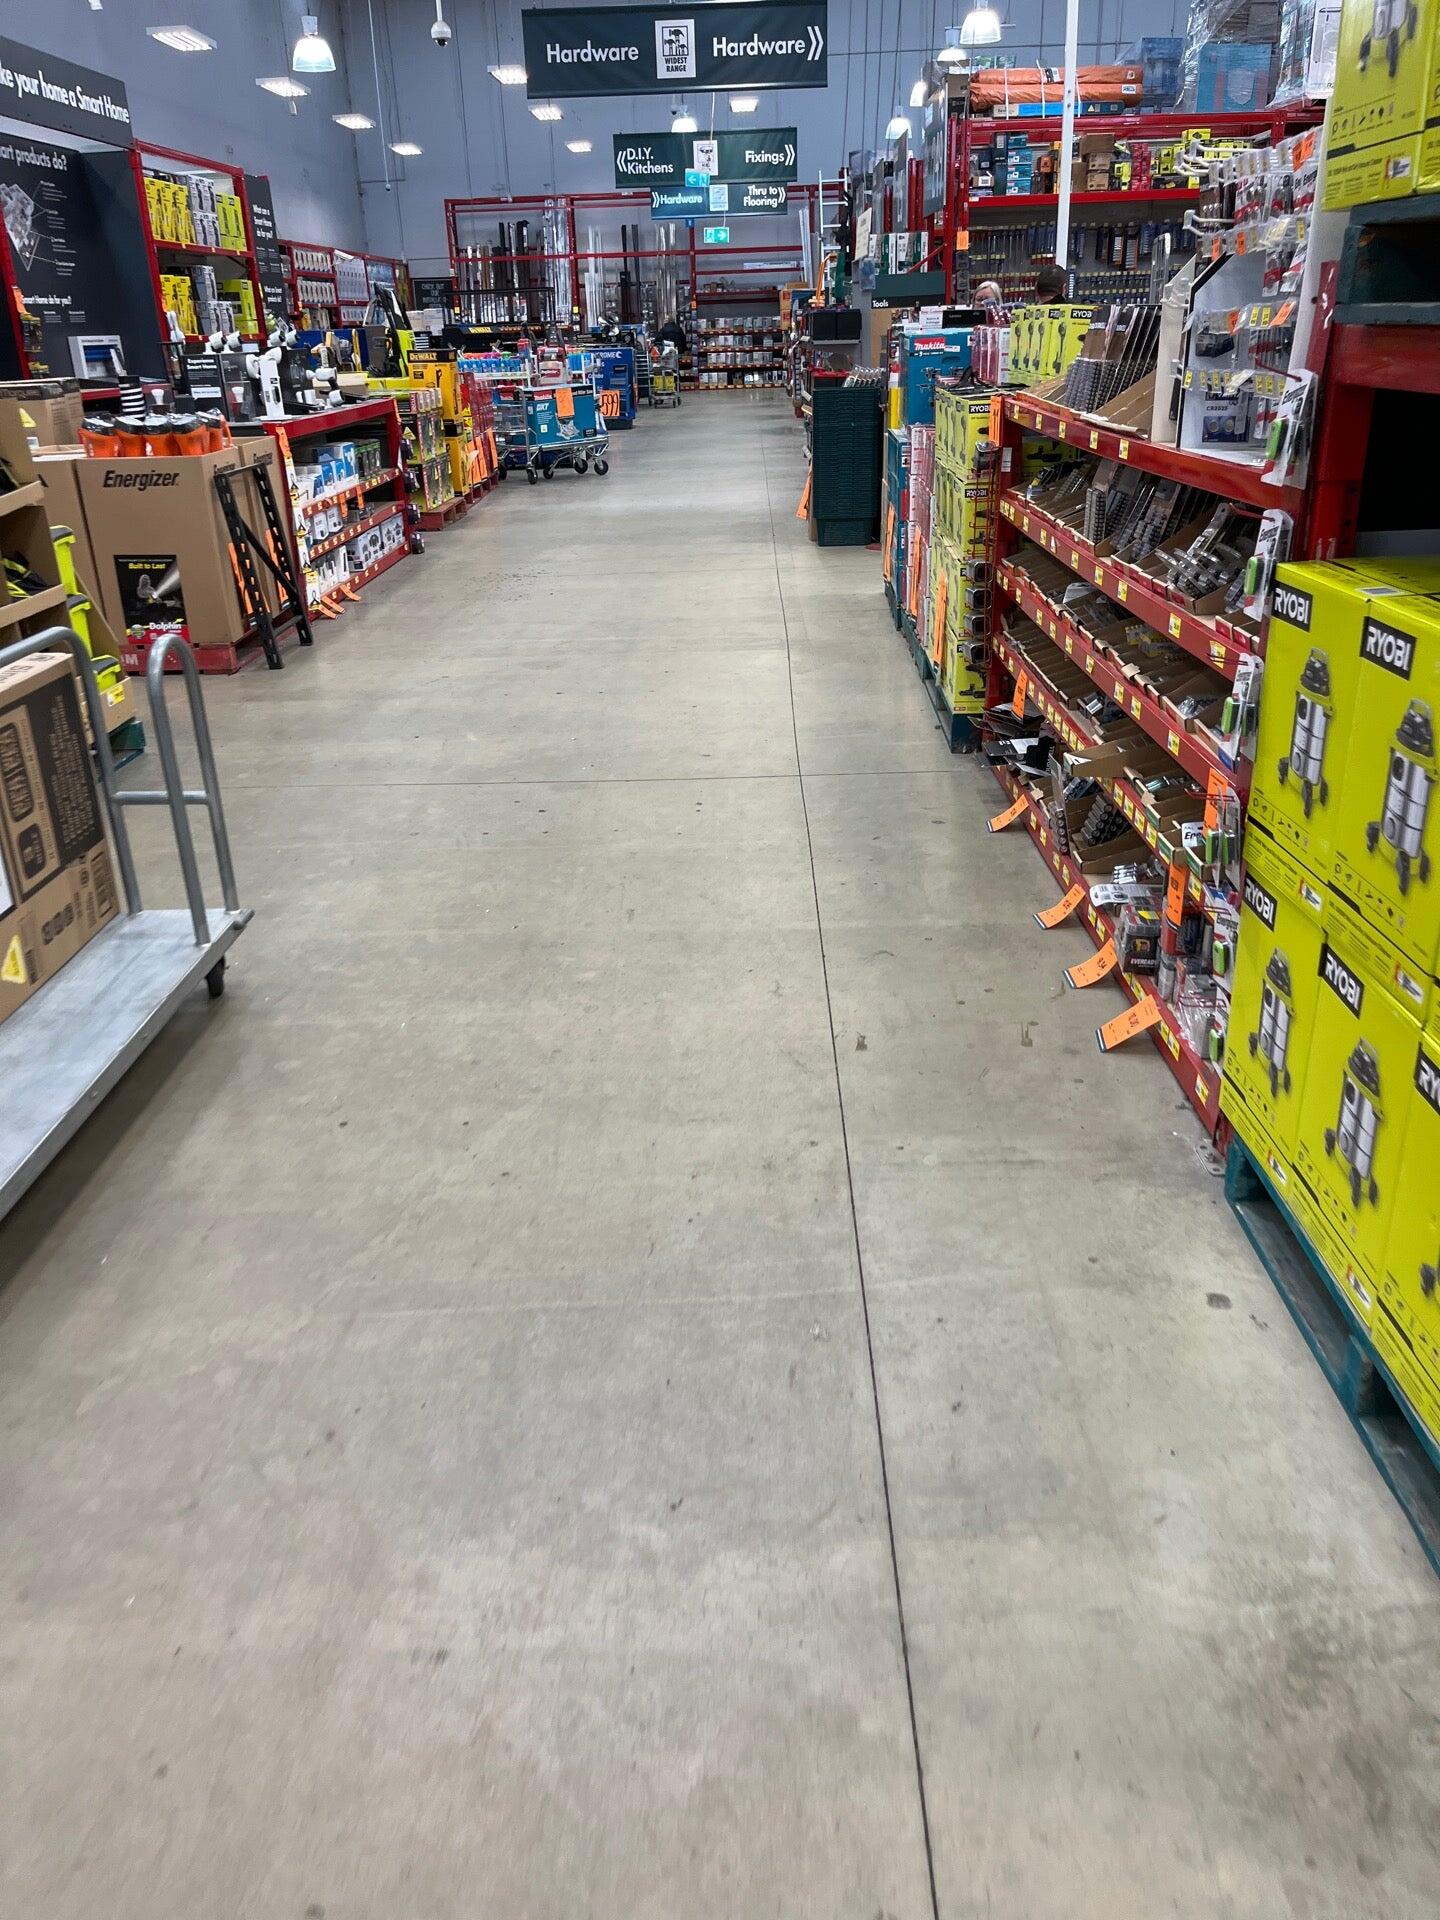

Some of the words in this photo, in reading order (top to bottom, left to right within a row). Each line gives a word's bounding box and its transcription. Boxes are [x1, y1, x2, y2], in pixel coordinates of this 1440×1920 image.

[546, 40, 639, 64] Hardware
[712, 33, 806, 58] Hardware
[664, 57, 688, 65] WIDEST
[666, 64, 687, 73] RANGE
[14, 72, 39, 98] your
[38, 70, 69, 105] home
[69, 90, 77, 108] a
[76, 85, 105, 116] Smart
[103, 95, 130, 124] Home
[15, 147, 51, 166] products
[52, 152, 67, 171] do?
[627, 148, 654, 161] D.I.Y.
[745, 150, 785, 165] Fixings
[627, 162, 674, 175] Kitchens
[748, 185, 767, 196] Thru
[768, 187, 778, 196] to
[660, 193, 703, 205] Hardware
[743, 197, 778, 208] Flooring
[1072, 310, 1093, 318] RYOB
[103, 469, 180, 491] Energizer
[1274, 588, 1309, 624] RYOBI
[149, 622, 182, 631] Dolphin
[1365, 626, 1413, 671] RYOBI
[1246, 878, 1274, 924] RYOBI
[1325, 952, 1361, 1011] RYOBI
